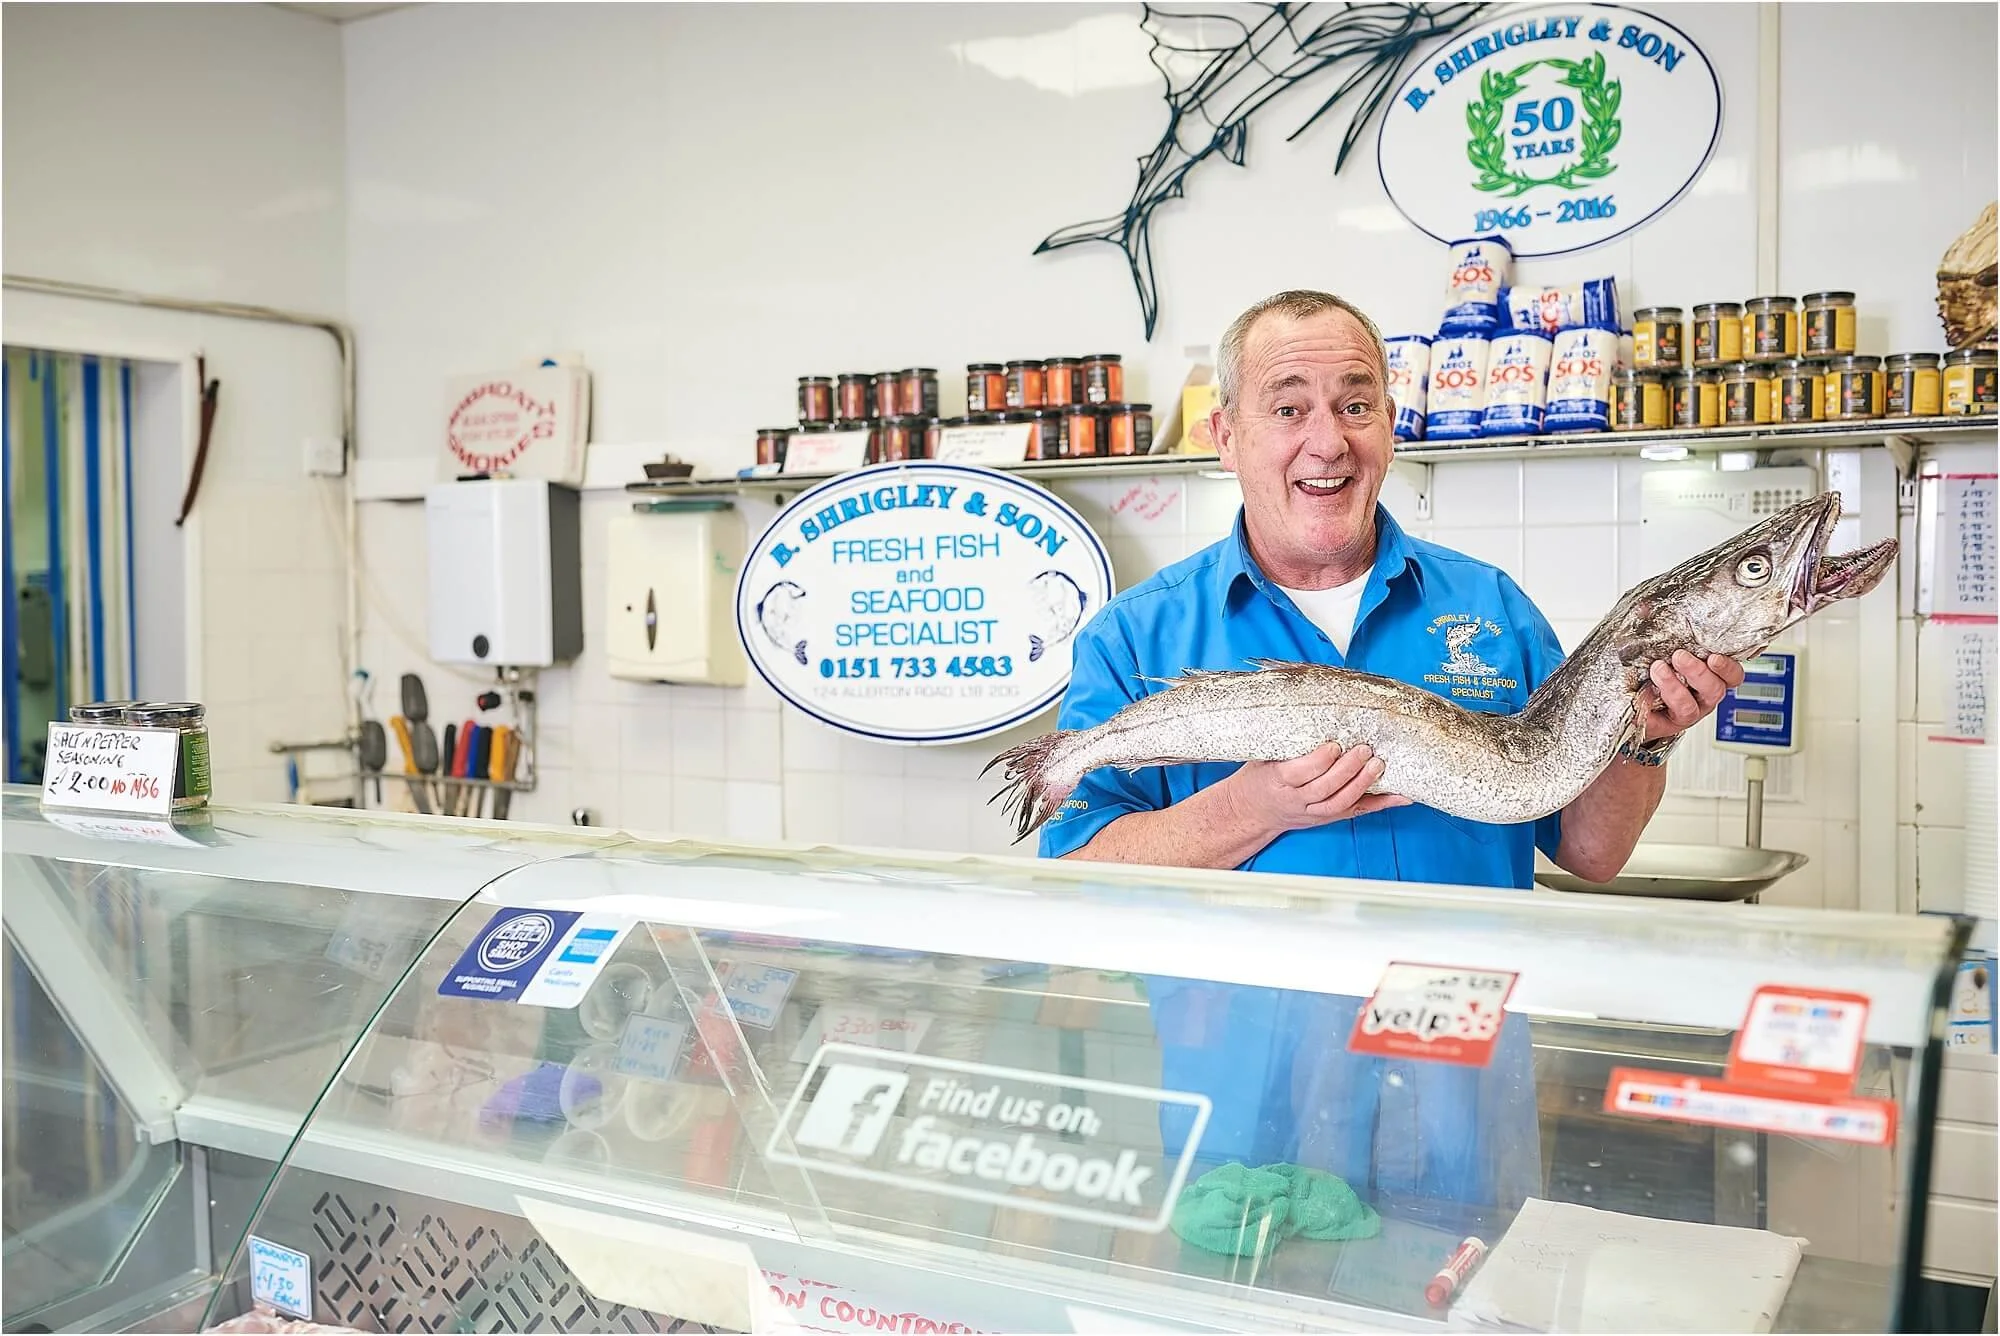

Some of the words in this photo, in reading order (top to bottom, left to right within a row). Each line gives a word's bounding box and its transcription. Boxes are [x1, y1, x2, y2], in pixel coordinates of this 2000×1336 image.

[1404, 86, 1436, 112] B.
[1434, 16, 1583, 86] SHRIGLEY
[1588, 18, 1611, 42] &
[1617, 24, 1686, 74] SON
[1511, 96, 1574, 138] 50
[1512, 138, 1576, 160] YEARS
[1473, 204, 1532, 232] 1966
[1556, 195, 1617, 223] 2016
[1452, 267, 1494, 288] SOS
[1435, 368, 1478, 390] SOS
[1490, 363, 1536, 385] SOS
[1555, 359, 1602, 379] SOS
[769, 540, 801, 568] B.
[799, 483, 958, 544] SHRIGLEY
[963, 491, 989, 518] &
[994, 502, 1069, 557] SON
[832, 537, 925, 565] FRESH
[935, 533, 1001, 560] FISH
[896, 564, 934, 584] and
[850, 586, 985, 615] SEAFOOD
[834, 619, 999, 648] SPECIALIST
[820, 657, 880, 679] 0151
[890, 656, 937, 679] 733
[946, 655, 1013, 678] 4583
[842, 685, 911, 698] ALLERTON
[914, 685, 953, 698] ROAD
[1423, 673, 1450, 684] FRESH
[1453, 675, 1473, 685] FISH
[1481, 677, 1518, 689] SEAFOOD
[1451, 687, 1496, 699] SPECIALIST
[91, 731, 142, 751] PEPPER
[56, 750, 126, 768] SEASONING
[110, 779, 127, 796] NO
[487, 948, 524, 961] SMALL
[497, 939, 530, 952] SHOP
[918, 1078, 1001, 1118] Find
[1000, 1096, 1047, 1127] us
[897, 1116, 1156, 1206] facebook
